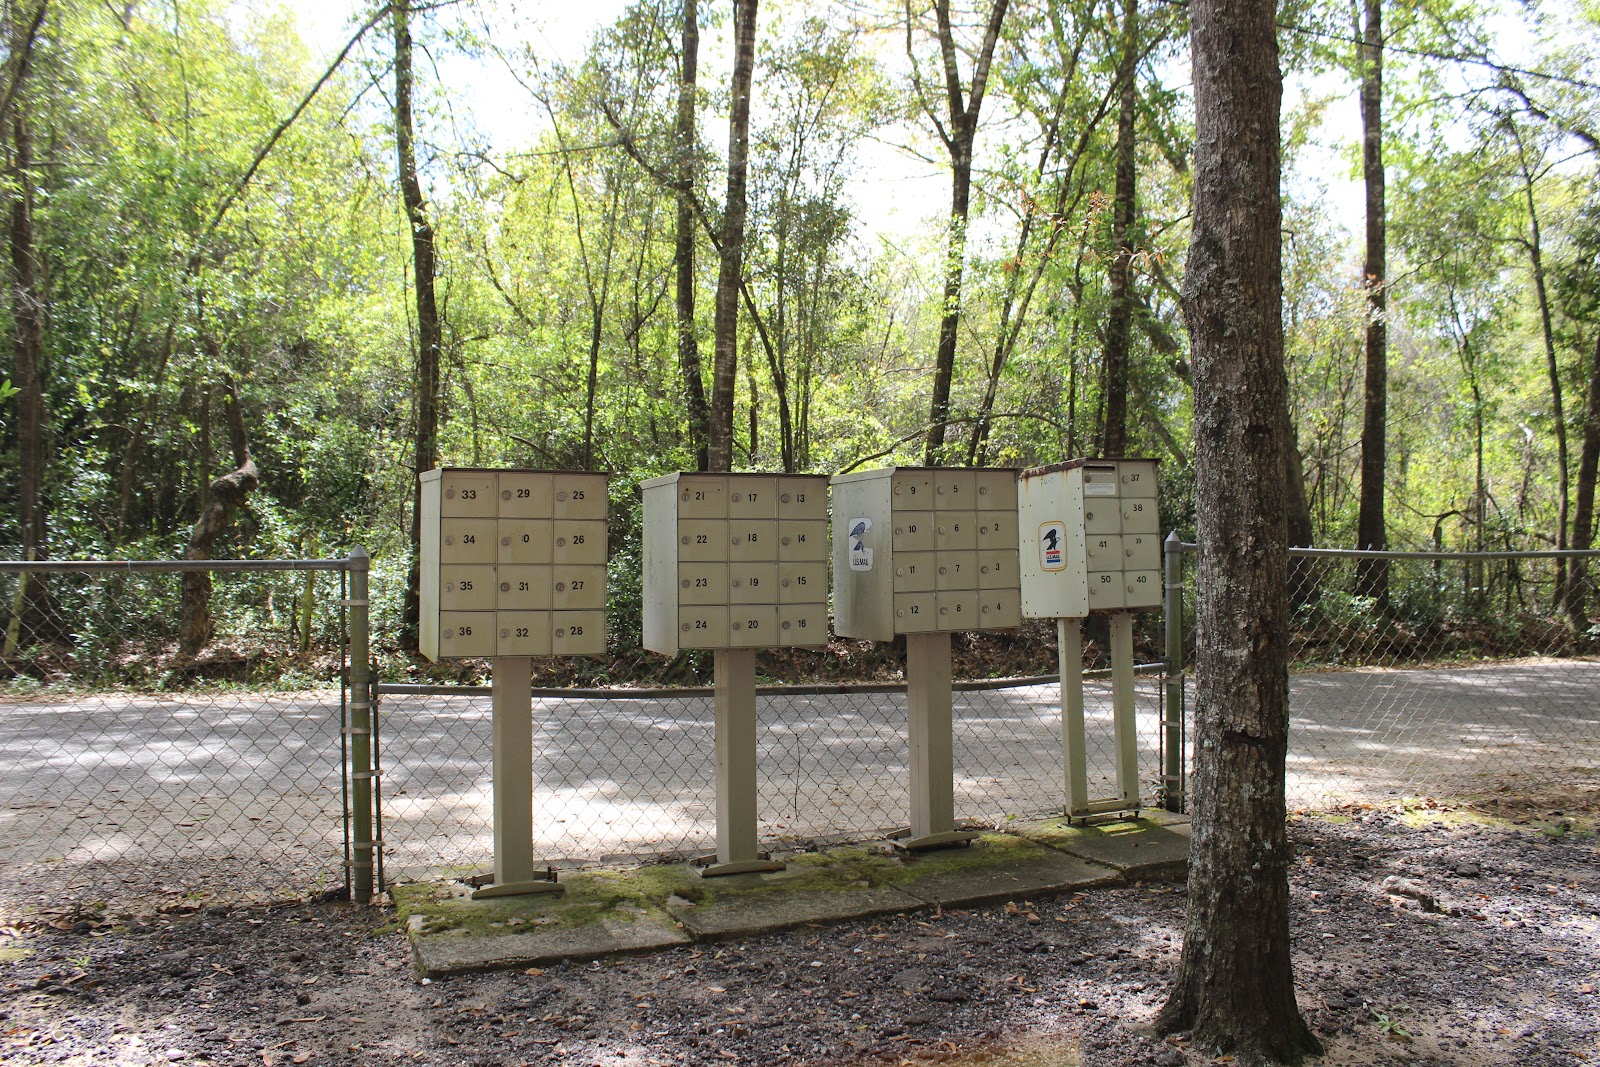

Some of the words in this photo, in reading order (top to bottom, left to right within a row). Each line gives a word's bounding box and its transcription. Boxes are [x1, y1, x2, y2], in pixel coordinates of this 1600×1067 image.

[1130, 473, 1140, 482] 37
[516, 488, 531, 499] 29
[910, 486, 916, 495] 9
[953, 484, 959, 493] 5
[461, 489, 477, 500] 33
[572, 490, 585, 500] 25
[695, 491, 705, 501] 21
[748, 493, 758, 503] 17
[796, 493, 805, 503] 13
[1133, 503, 1143, 512] 38
[908, 525, 917, 534] 10
[954, 523, 960, 533] 6
[994, 523, 1000, 532] 2
[463, 534, 476, 545] 34
[573, 534, 585, 545] 26
[696, 534, 708, 544] 22
[748, 533, 758, 543] 18
[798, 534, 806, 543] 14
[1098, 540, 1107, 549] 41
[909, 565, 915, 574] 11
[955, 564, 960, 573] 7
[995, 562, 1000, 571] 3
[695, 577, 708, 588] 23
[749, 577, 759, 587] 19
[797, 576, 807, 585] 15
[1100, 575, 1112, 584] 50
[1136, 575, 1147, 584] 40
[459, 581, 473, 591] 35
[518, 581, 529, 592] 31
[571, 580, 584, 590] 27
[910, 605, 919, 615] 12
[956, 603, 962, 613] 8
[996, 602, 1001, 611] 4
[695, 620, 708, 630] 24
[747, 619, 759, 629] 20
[797, 619, 807, 628] 16
[459, 626, 472, 637] 36
[516, 627, 529, 638] 32
[569, 626, 584, 636] 28
